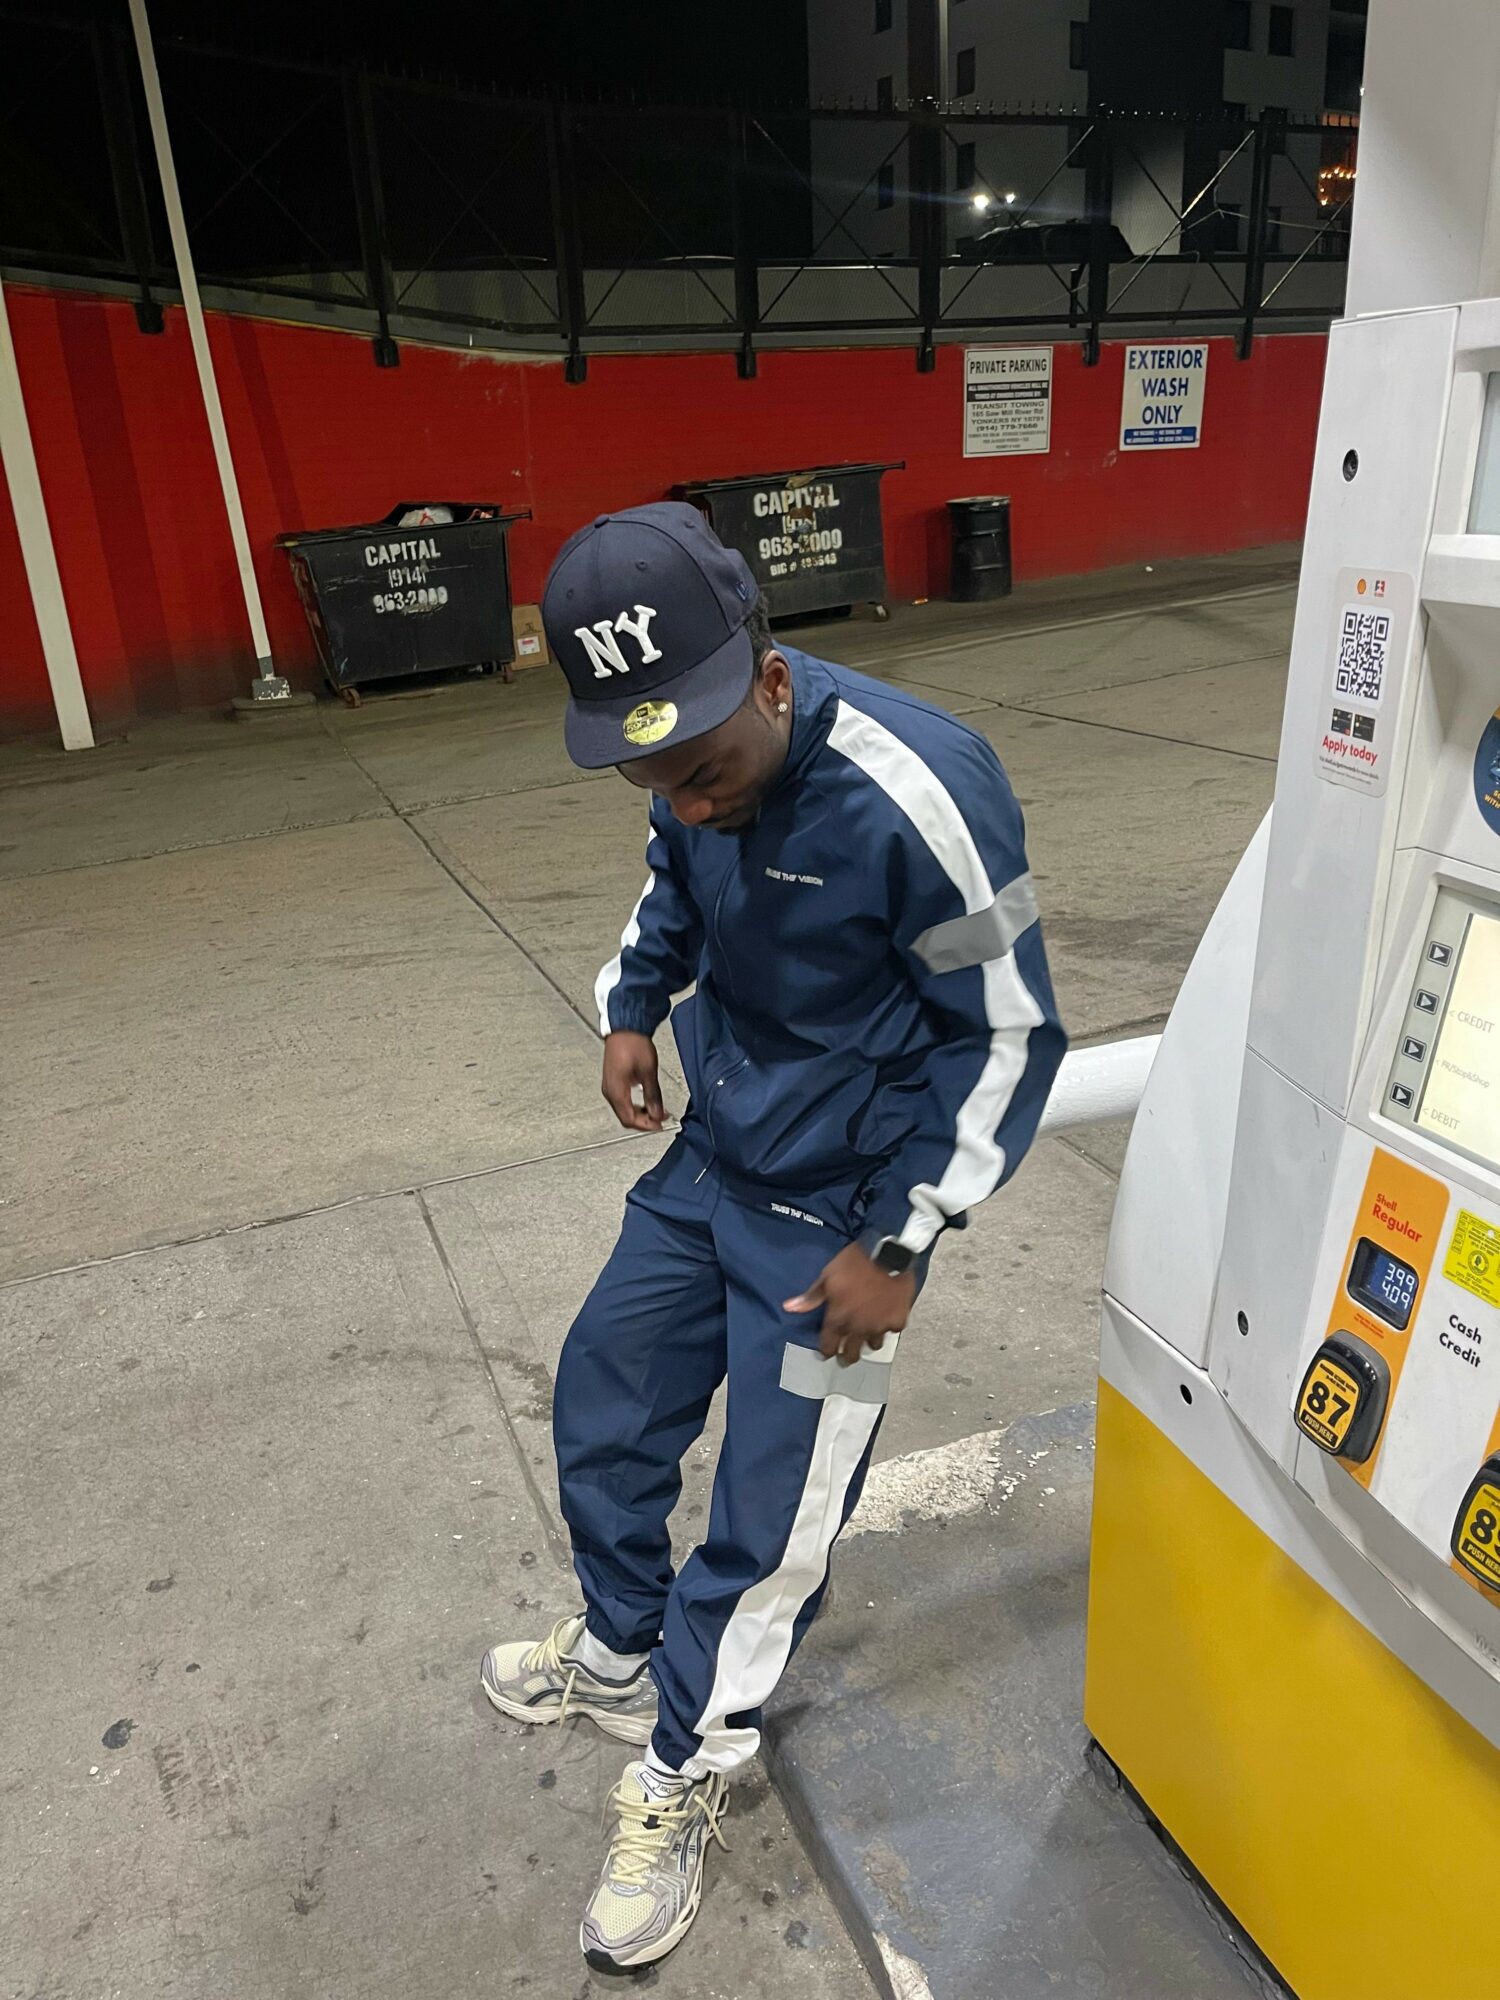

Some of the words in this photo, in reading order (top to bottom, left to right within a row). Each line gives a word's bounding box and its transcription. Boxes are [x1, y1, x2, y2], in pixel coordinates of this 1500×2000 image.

[970, 360, 1006, 374] PRIVATE
[1009, 359, 1047, 372] PARKING
[1129, 349, 1203, 369] EXTERIOR
[1142, 377, 1189, 397] WASH
[1142, 405, 1183, 424] ONLY
[753, 483, 840, 517] CAPITAL
[365, 538, 441, 567] CAPITAL
[373, 586, 448, 614] 963-2000
[574, 604, 663, 679] NY
[1322, 735, 1348, 757] Apply
[1350, 744, 1378, 766] today
[1457, 1011, 1495, 1033] CREDIT
[1431, 1109, 1460, 1130] DEBIT
[1375, 1193, 1397, 1211] Shell
[1372, 1204, 1422, 1242] Regular
[1449, 1314, 1482, 1344] Cash
[1439, 1332, 1481, 1368] Credit
[1307, 1381, 1350, 1428] 87
[1305, 1415, 1319, 1430] PUSH
[1319, 1426, 1334, 1442] HERE
[1470, 1508, 1500, 1558] 8
[1467, 1544, 1486, 1562] PUSH
